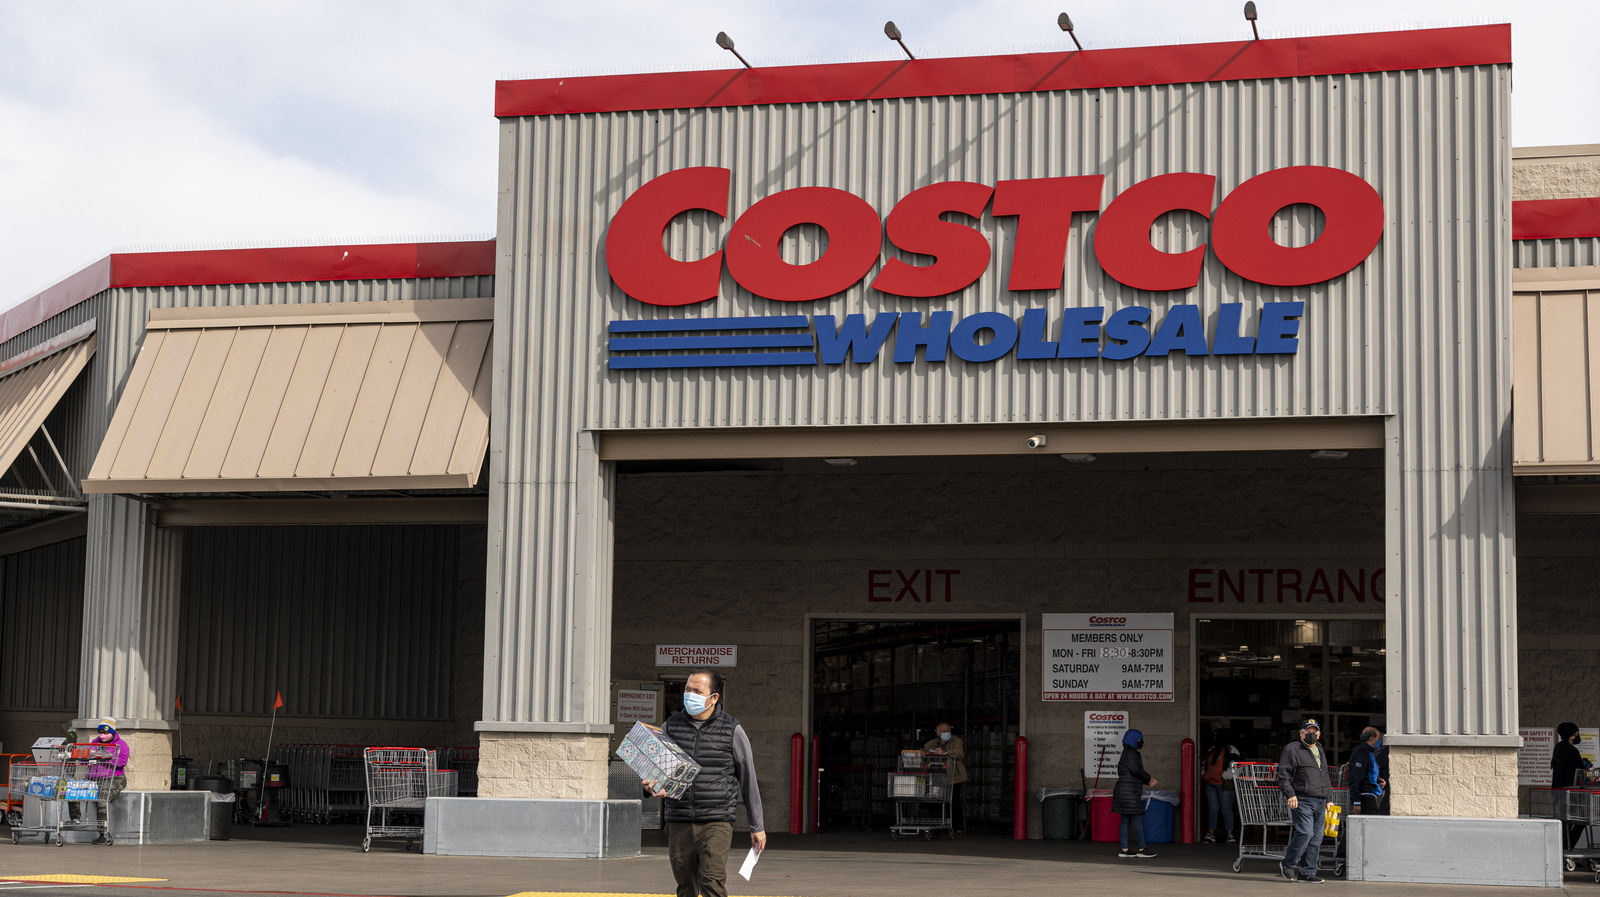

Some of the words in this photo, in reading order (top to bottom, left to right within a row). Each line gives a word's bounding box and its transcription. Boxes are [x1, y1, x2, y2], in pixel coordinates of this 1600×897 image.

[606, 165, 1384, 306] COSTCO
[813, 301, 1305, 365] WHOLESALE
[868, 569, 961, 602] EXIT
[1089, 616, 1127, 624] COSTCO
[1071, 634, 1117, 642] MEMBERS
[1120, 634, 1144, 642] ONLY
[660, 647, 733, 656] MERCHANDISE
[1052, 649, 1074, 658] MON
[1082, 649, 1096, 658] FRI
[672, 656, 720, 664] RETURNS
[1052, 664, 1100, 673] SATURDAY
[1122, 664, 1164, 673] 9AM-7PM
[1052, 680, 1088, 688] SUNDAY
[1122, 680, 1164, 688] 9AM-7PM
